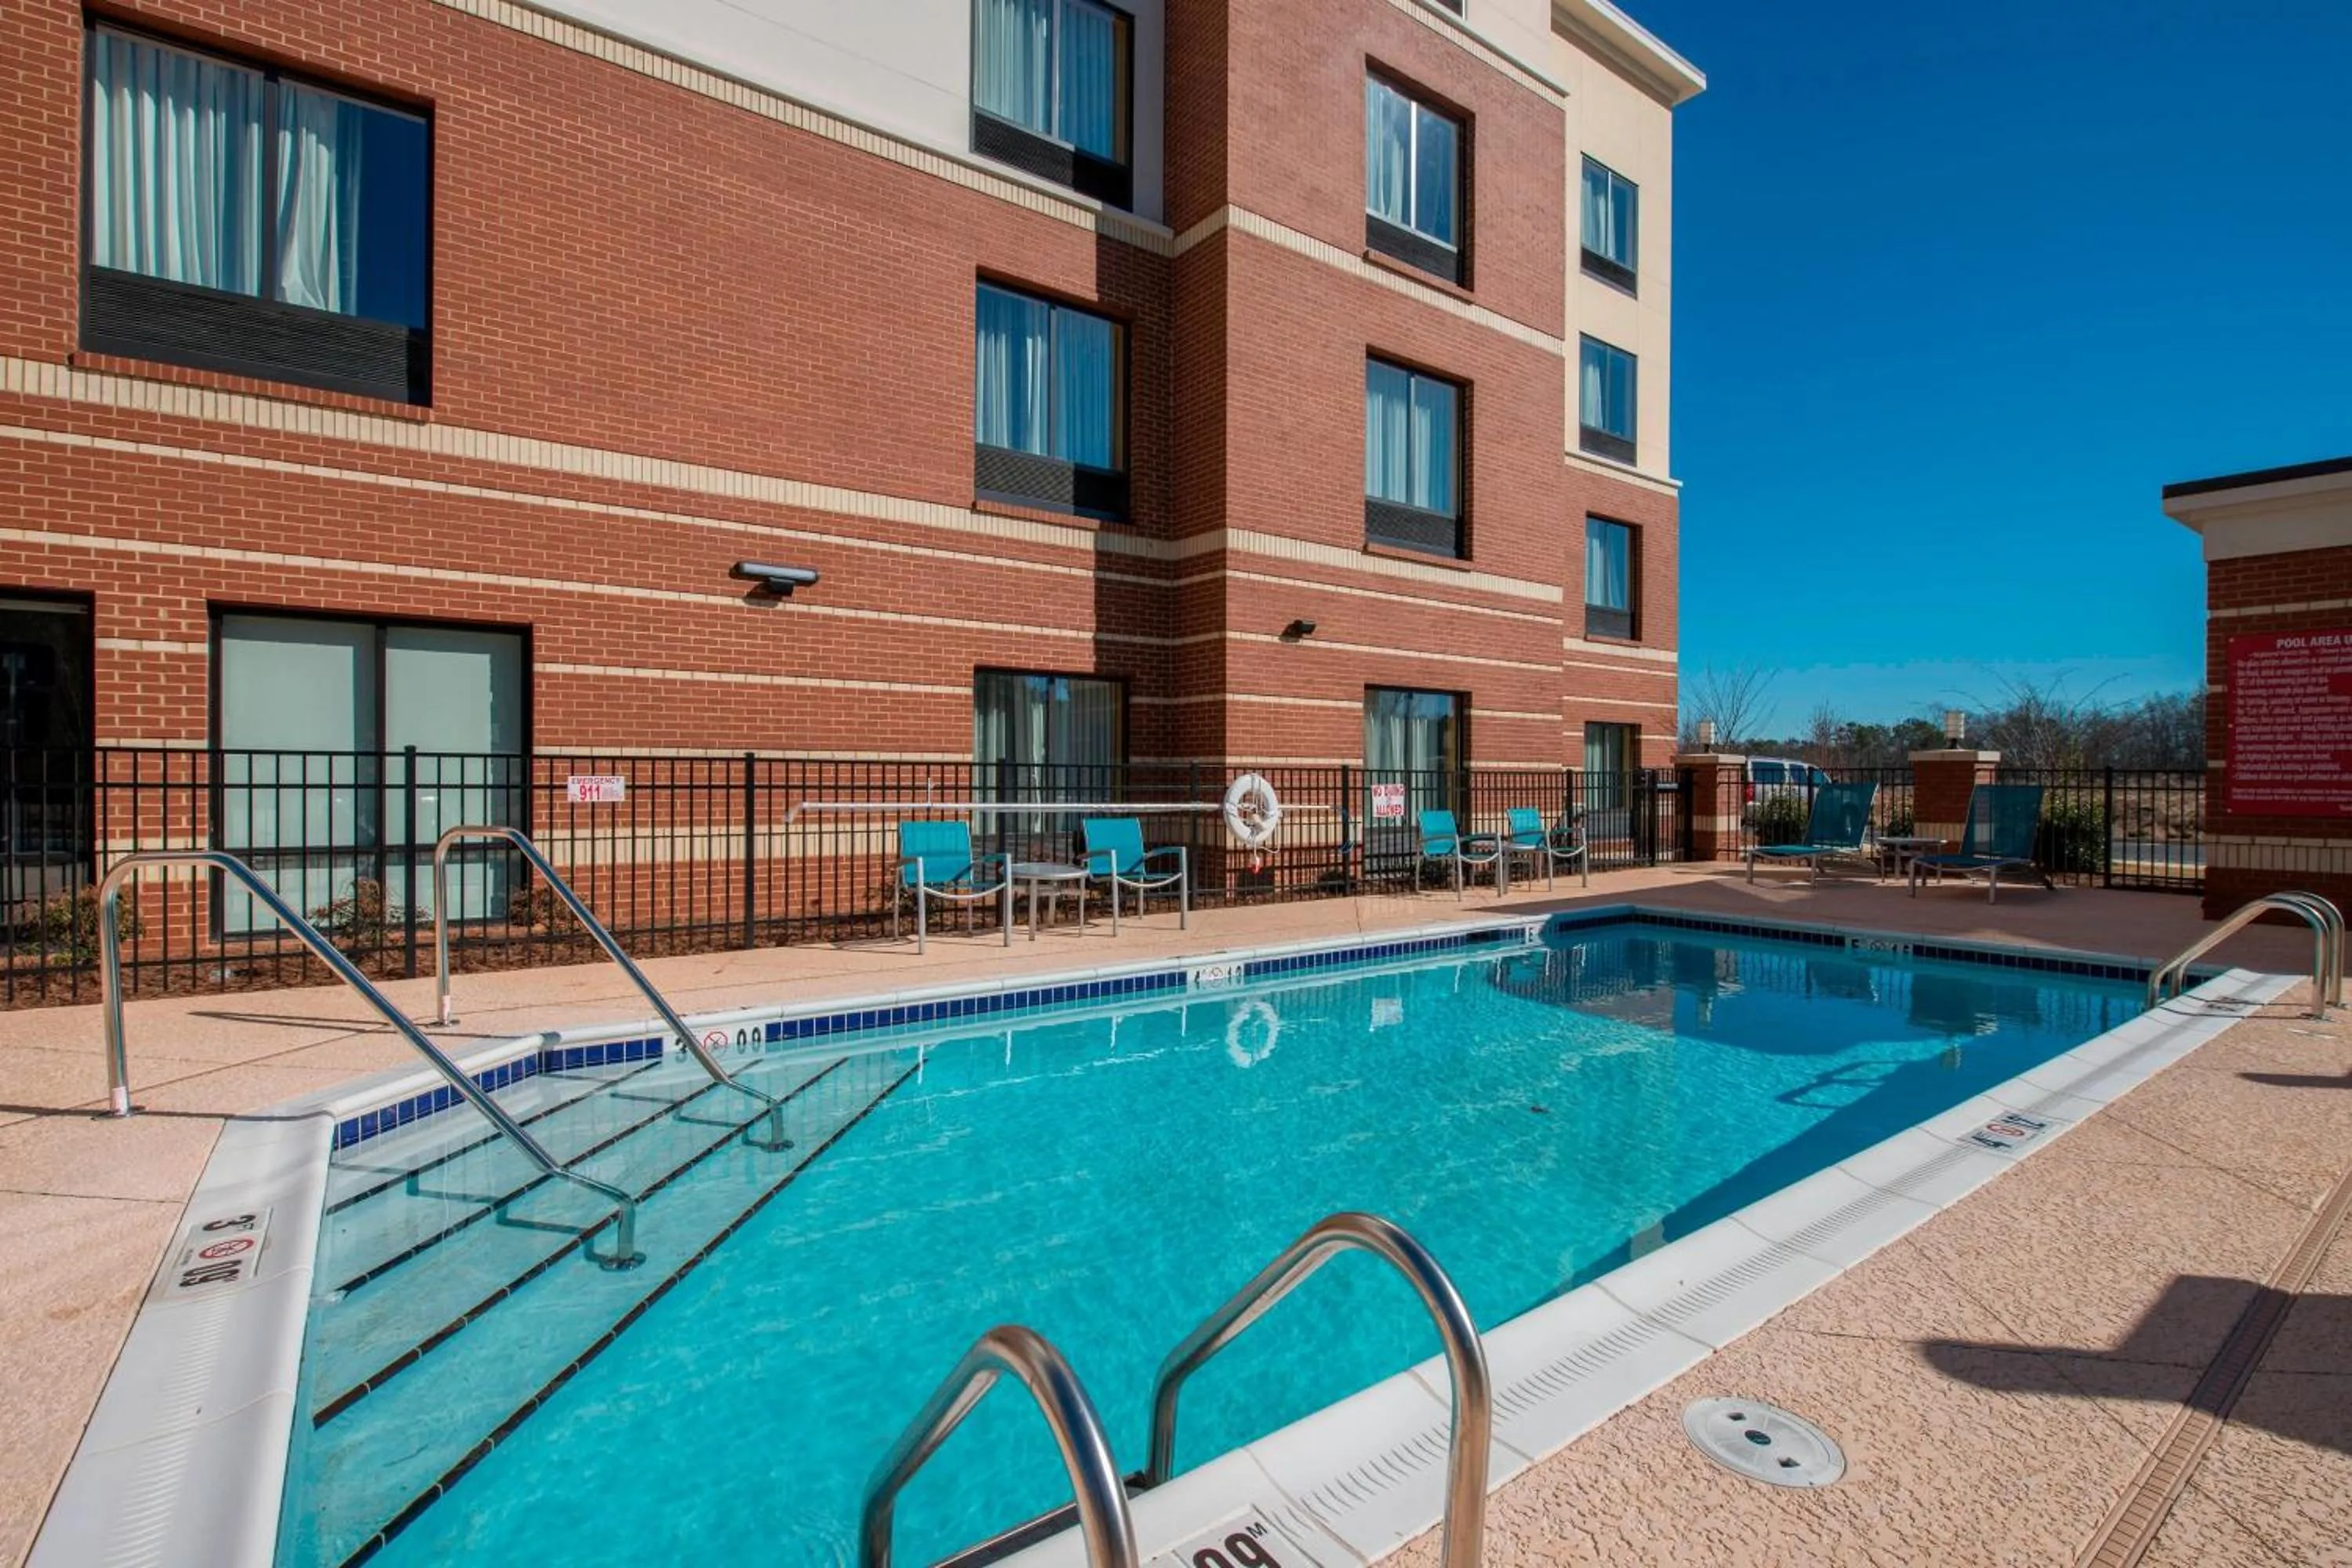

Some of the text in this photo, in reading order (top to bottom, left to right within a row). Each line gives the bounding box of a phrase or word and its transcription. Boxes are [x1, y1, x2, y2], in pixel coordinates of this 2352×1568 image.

[2277, 637, 2307, 648] POOL
[2310, 636, 2341, 647] AREA
[579, 785, 601, 800] 911
